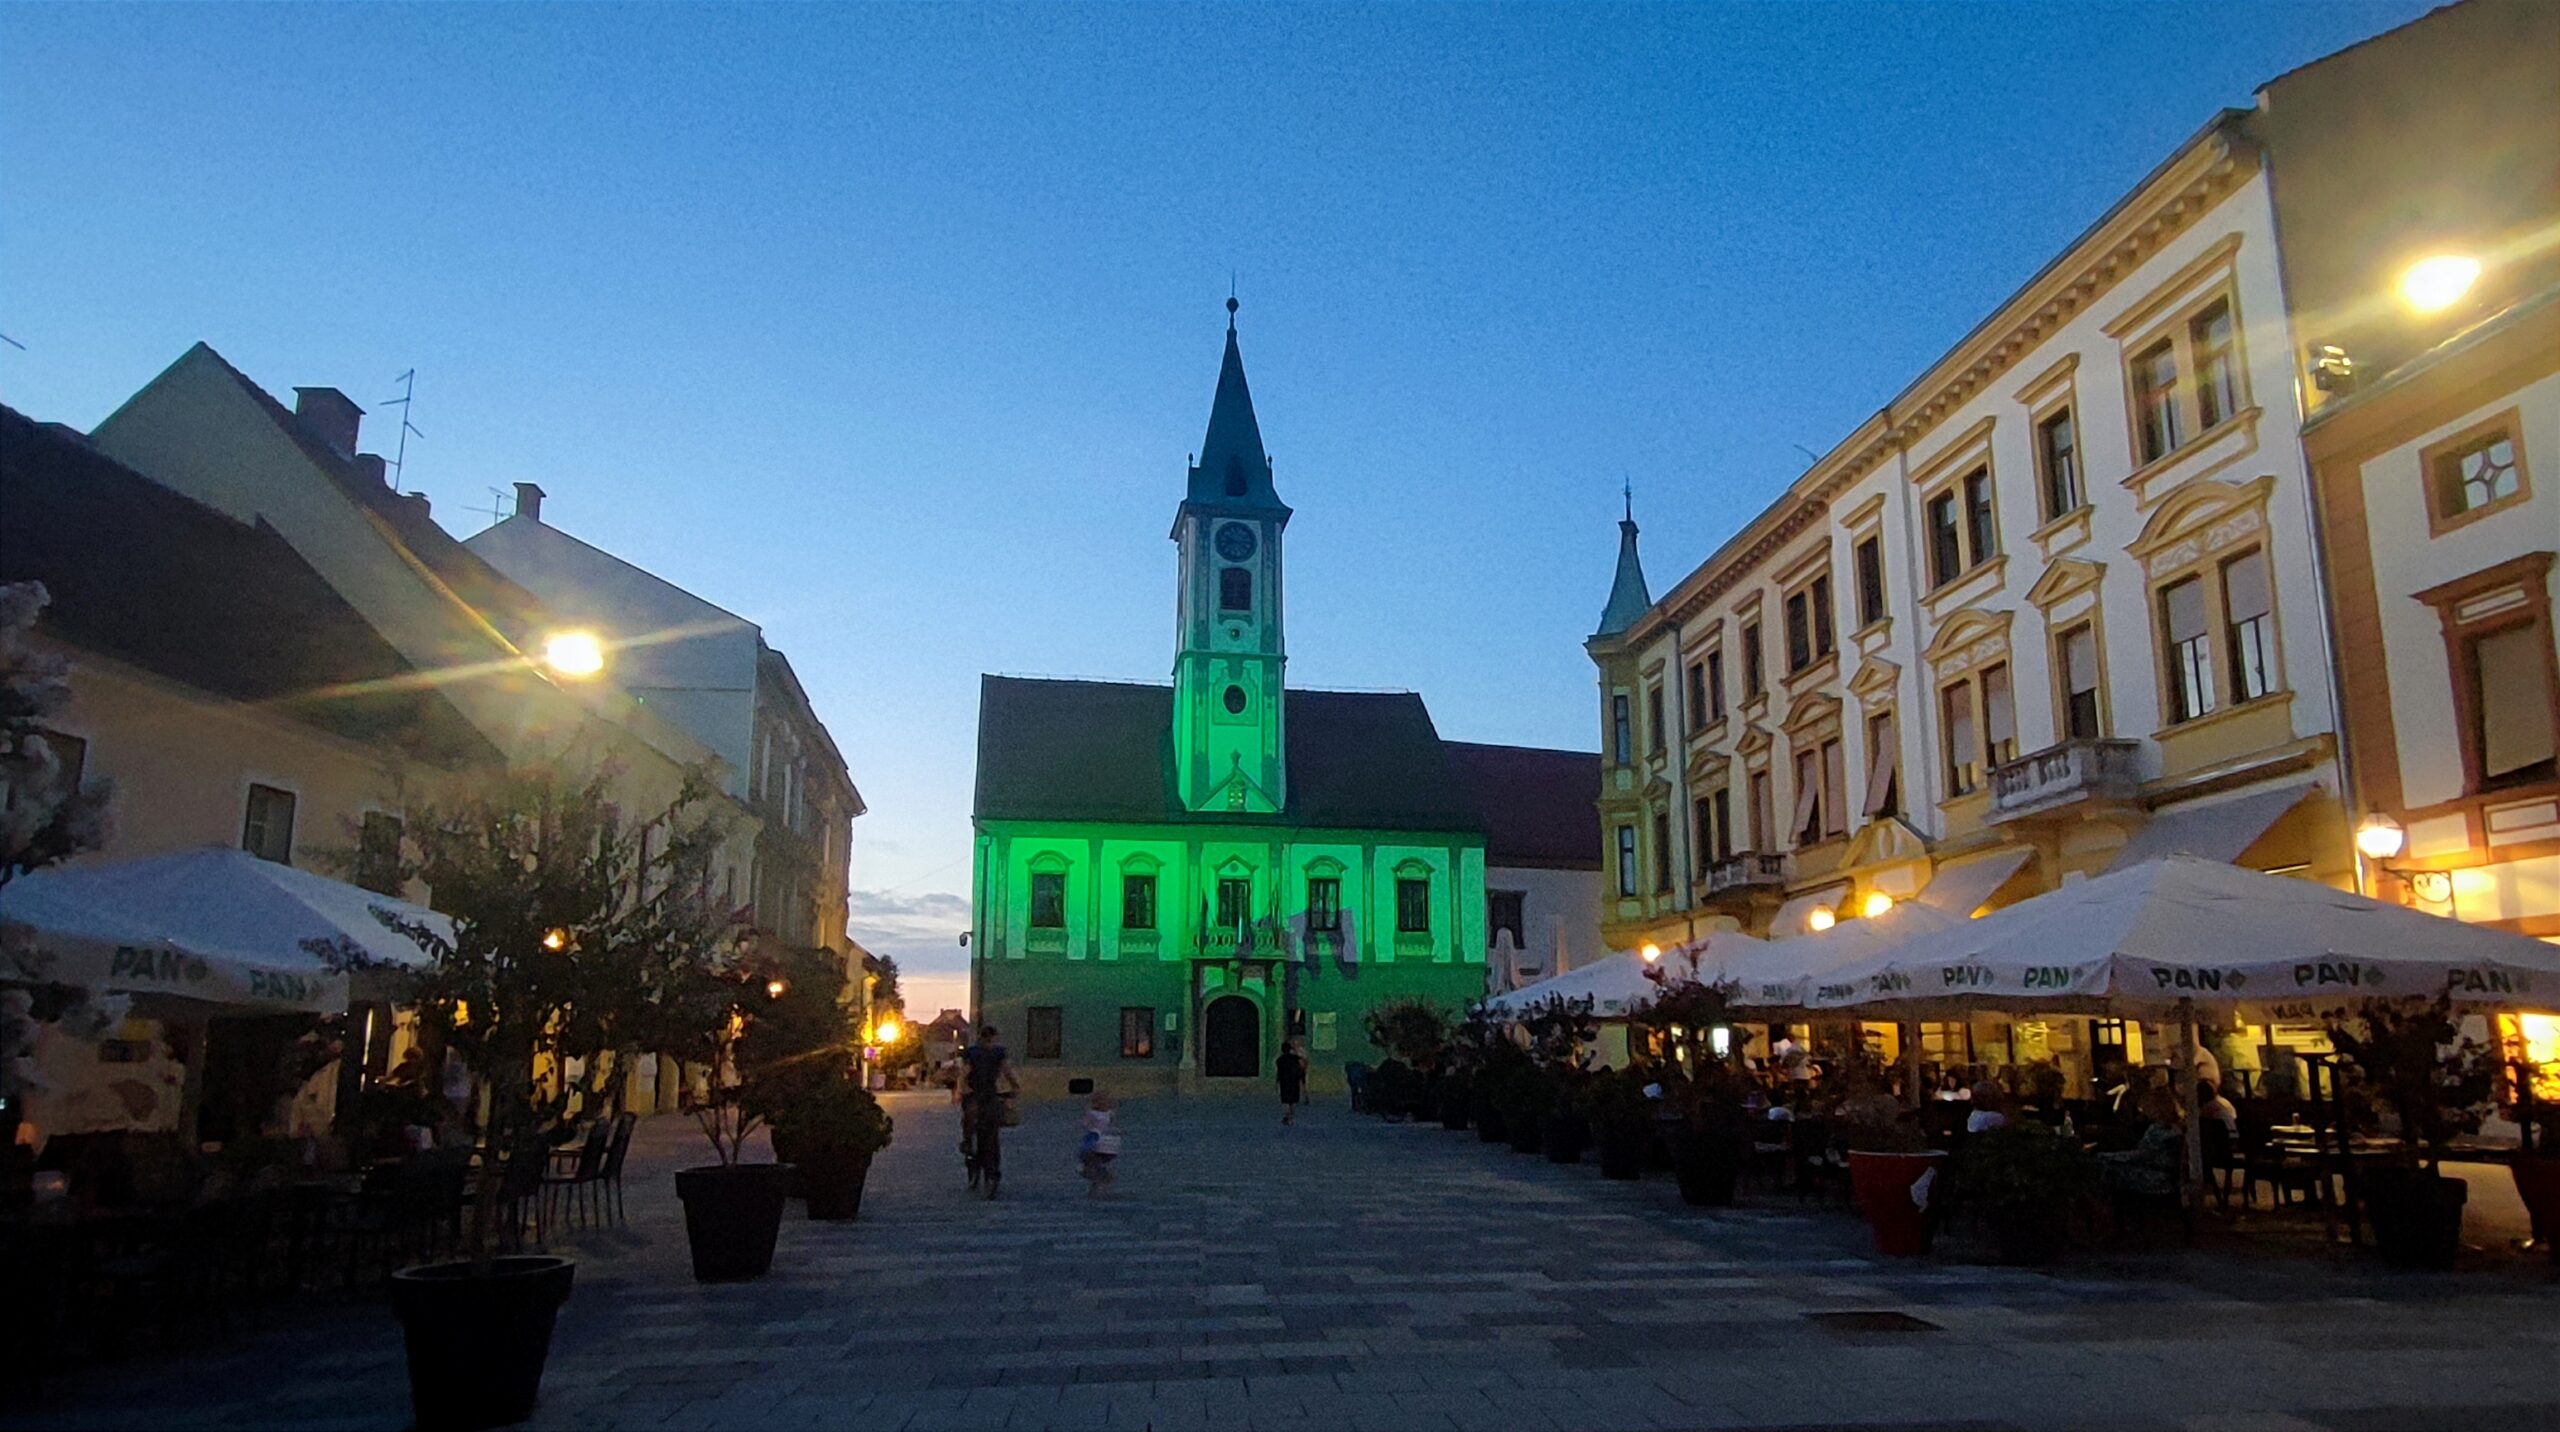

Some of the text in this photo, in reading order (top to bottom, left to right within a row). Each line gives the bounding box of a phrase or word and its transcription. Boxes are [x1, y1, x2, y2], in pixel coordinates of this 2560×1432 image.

[110, 946, 181, 981] PAN
[2294, 964, 2360, 986] PAN
[250, 970, 307, 1000] PAN
[1942, 966, 1981, 987] PAN
[2024, 967, 2070, 988] PAN
[2151, 967, 2222, 990] PAN
[2448, 969, 2512, 993] PAN
